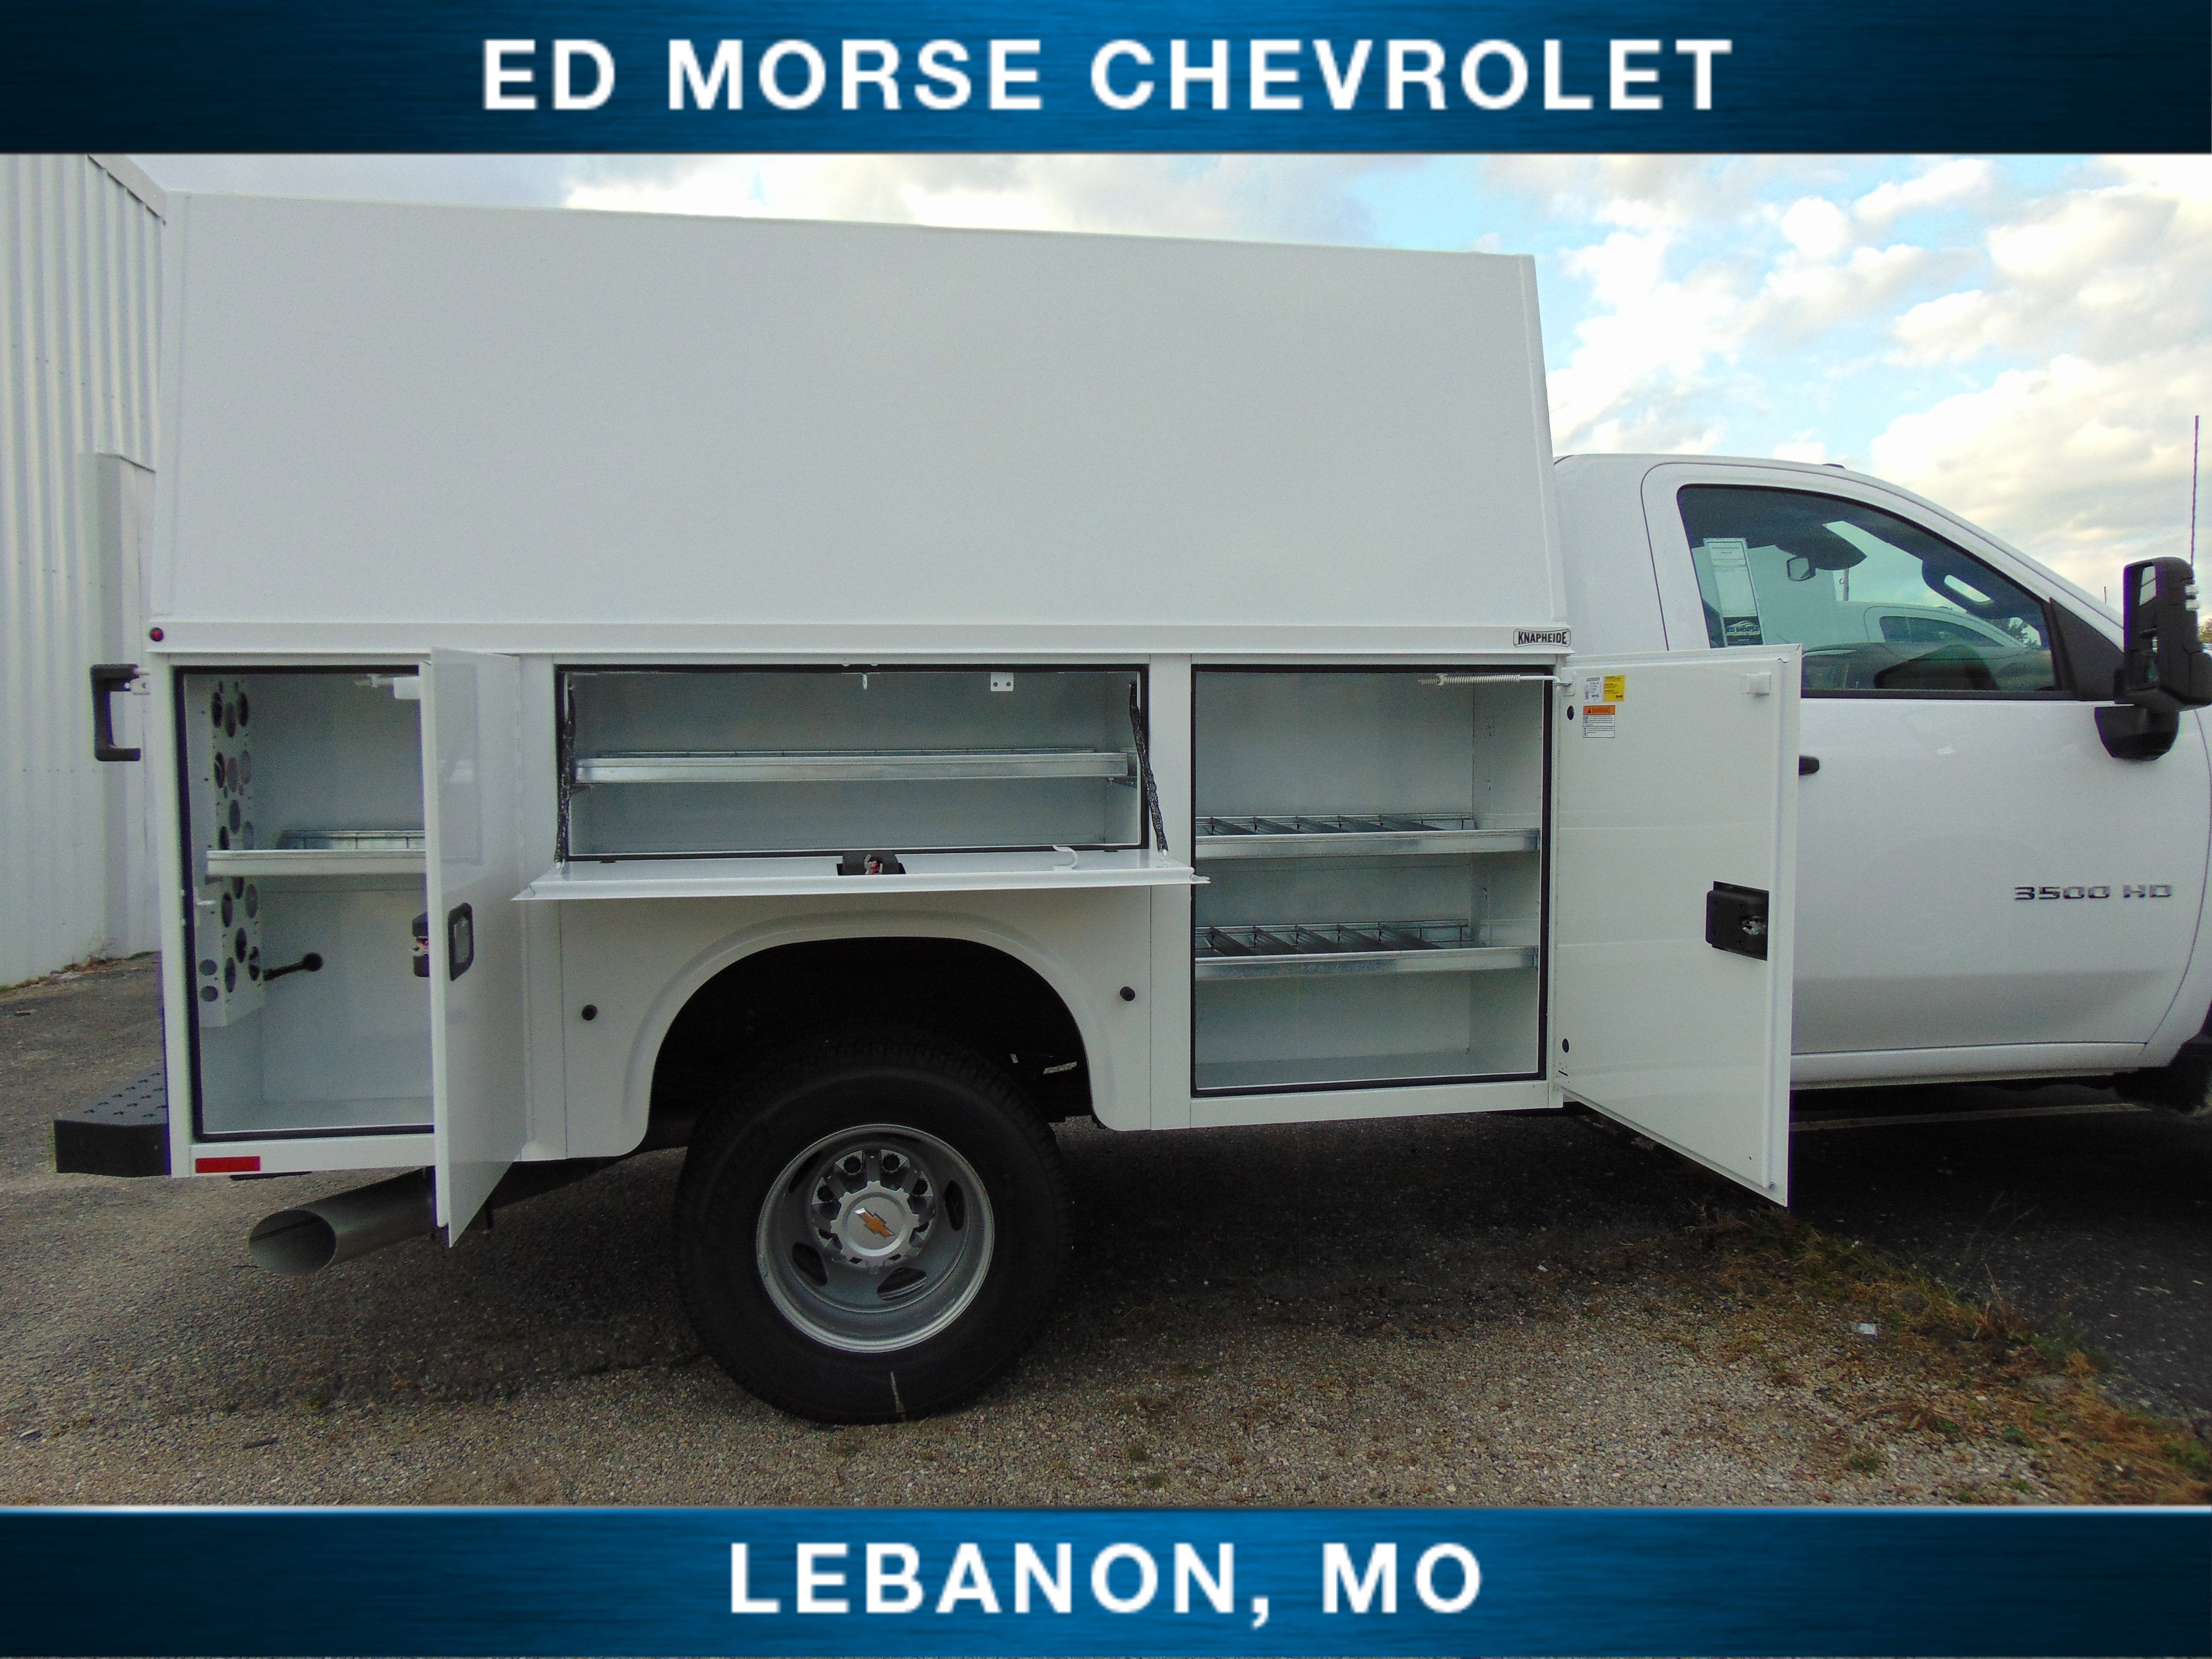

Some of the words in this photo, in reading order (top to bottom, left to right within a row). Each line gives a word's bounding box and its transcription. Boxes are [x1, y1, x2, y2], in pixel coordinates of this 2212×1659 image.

[1518, 631, 1567, 644] KNAPHEIDE
[2014, 886, 2110, 900] 3500
[2123, 884, 2172, 899] HD
